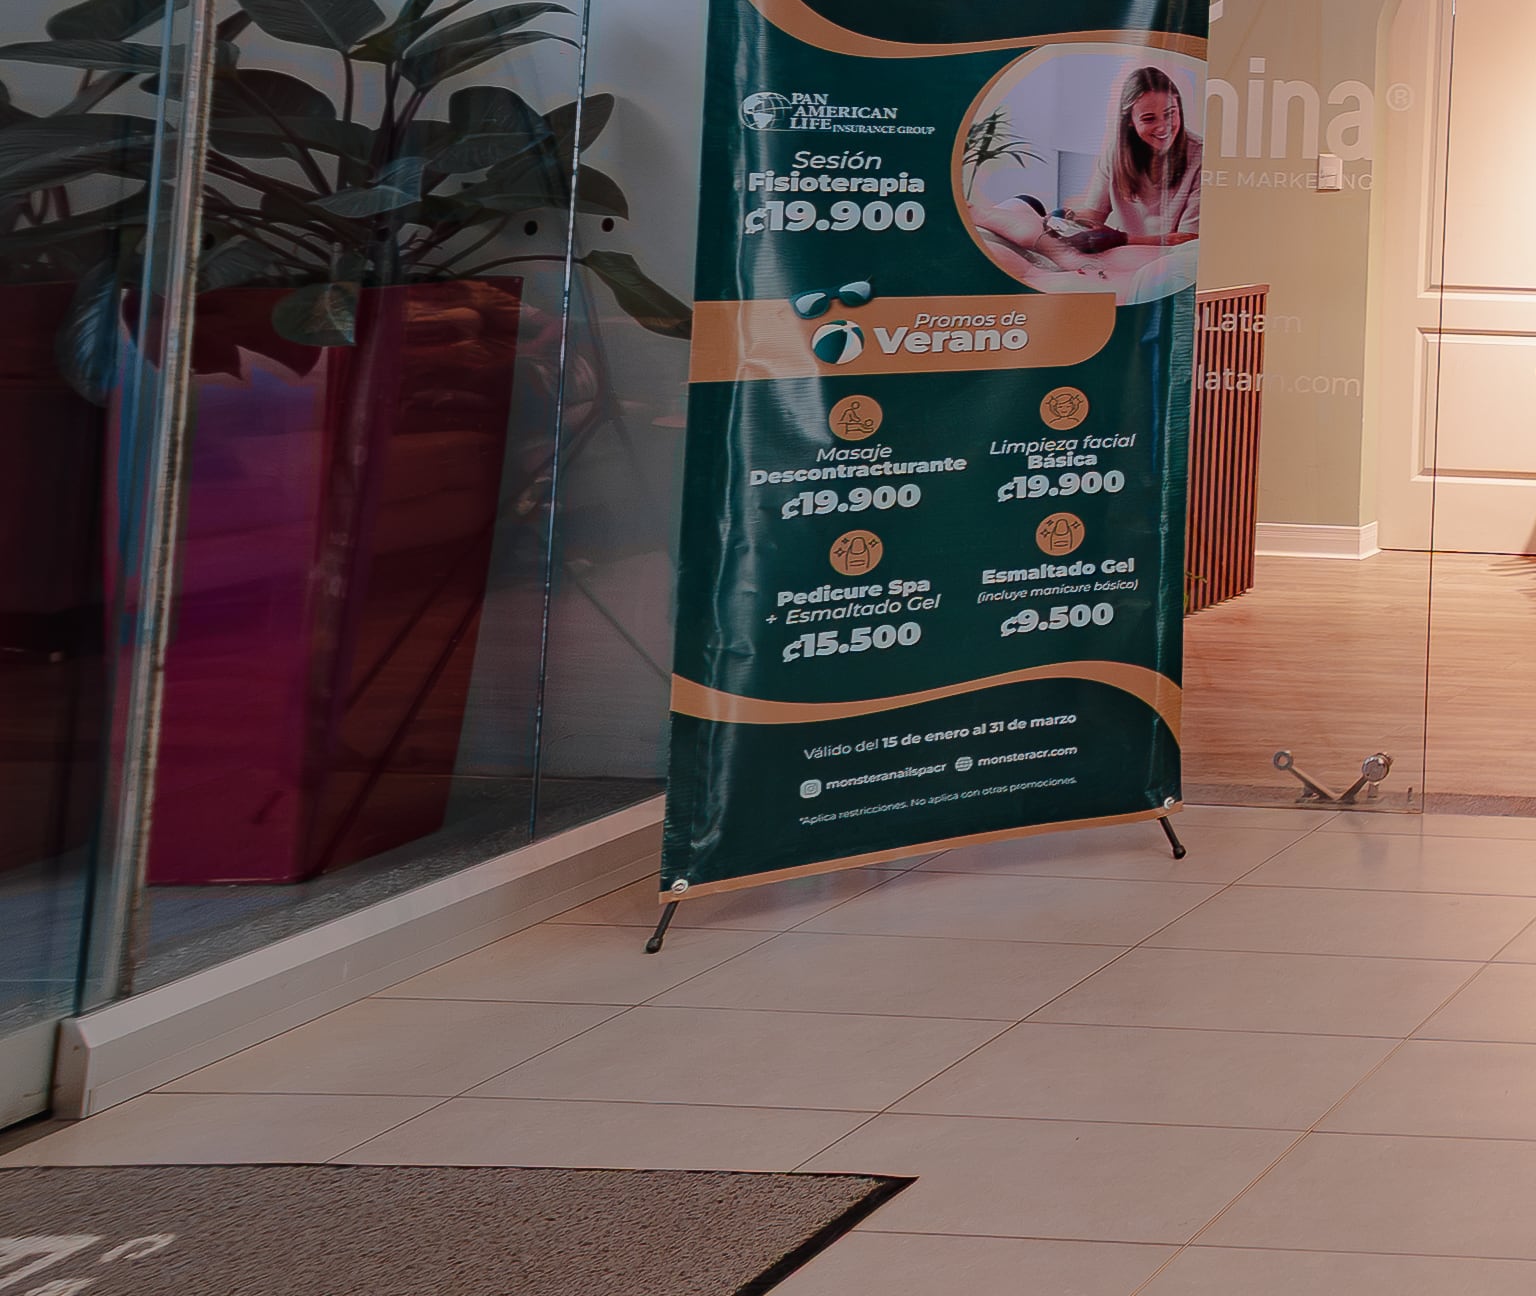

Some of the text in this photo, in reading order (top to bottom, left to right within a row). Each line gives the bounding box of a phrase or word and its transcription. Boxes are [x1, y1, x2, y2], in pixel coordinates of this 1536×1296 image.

[791, 92, 829, 106] PAN
[789, 117, 832, 131] LIFE
[793, 106, 898, 120] AMERICAN
[832, 125, 936, 136] INSURANCE GROUP
[792, 150, 882, 170] Sesión
[748, 170, 925, 197] Fisioterapia
[914, 310, 1028, 329] Promos de
[875, 327, 1029, 356] Verano
[815, 443, 893, 464] Masaje
[989, 433, 1137, 457] Limpieza facial
[750, 457, 968, 486] Descontracturante
[1027, 450, 1098, 470] Básica
[982, 557, 1136, 585] Esmaltado Gel
[777, 579, 931, 607] Pedicure Spa
[976, 578, 1140, 604] (incluye manicure básico)
[765, 593, 942, 625] + Esmaltado Gel
[803, 713, 1077, 761] Válido del 15 de enero al 31 de marzo
[977, 745, 1078, 768] monsteracr.com
[825, 762, 947, 791] monsteranailspacr
[927, 791, 960, 807] aplica
[961, 788, 981, 800] con
[982, 782, 1009, 797] otras
